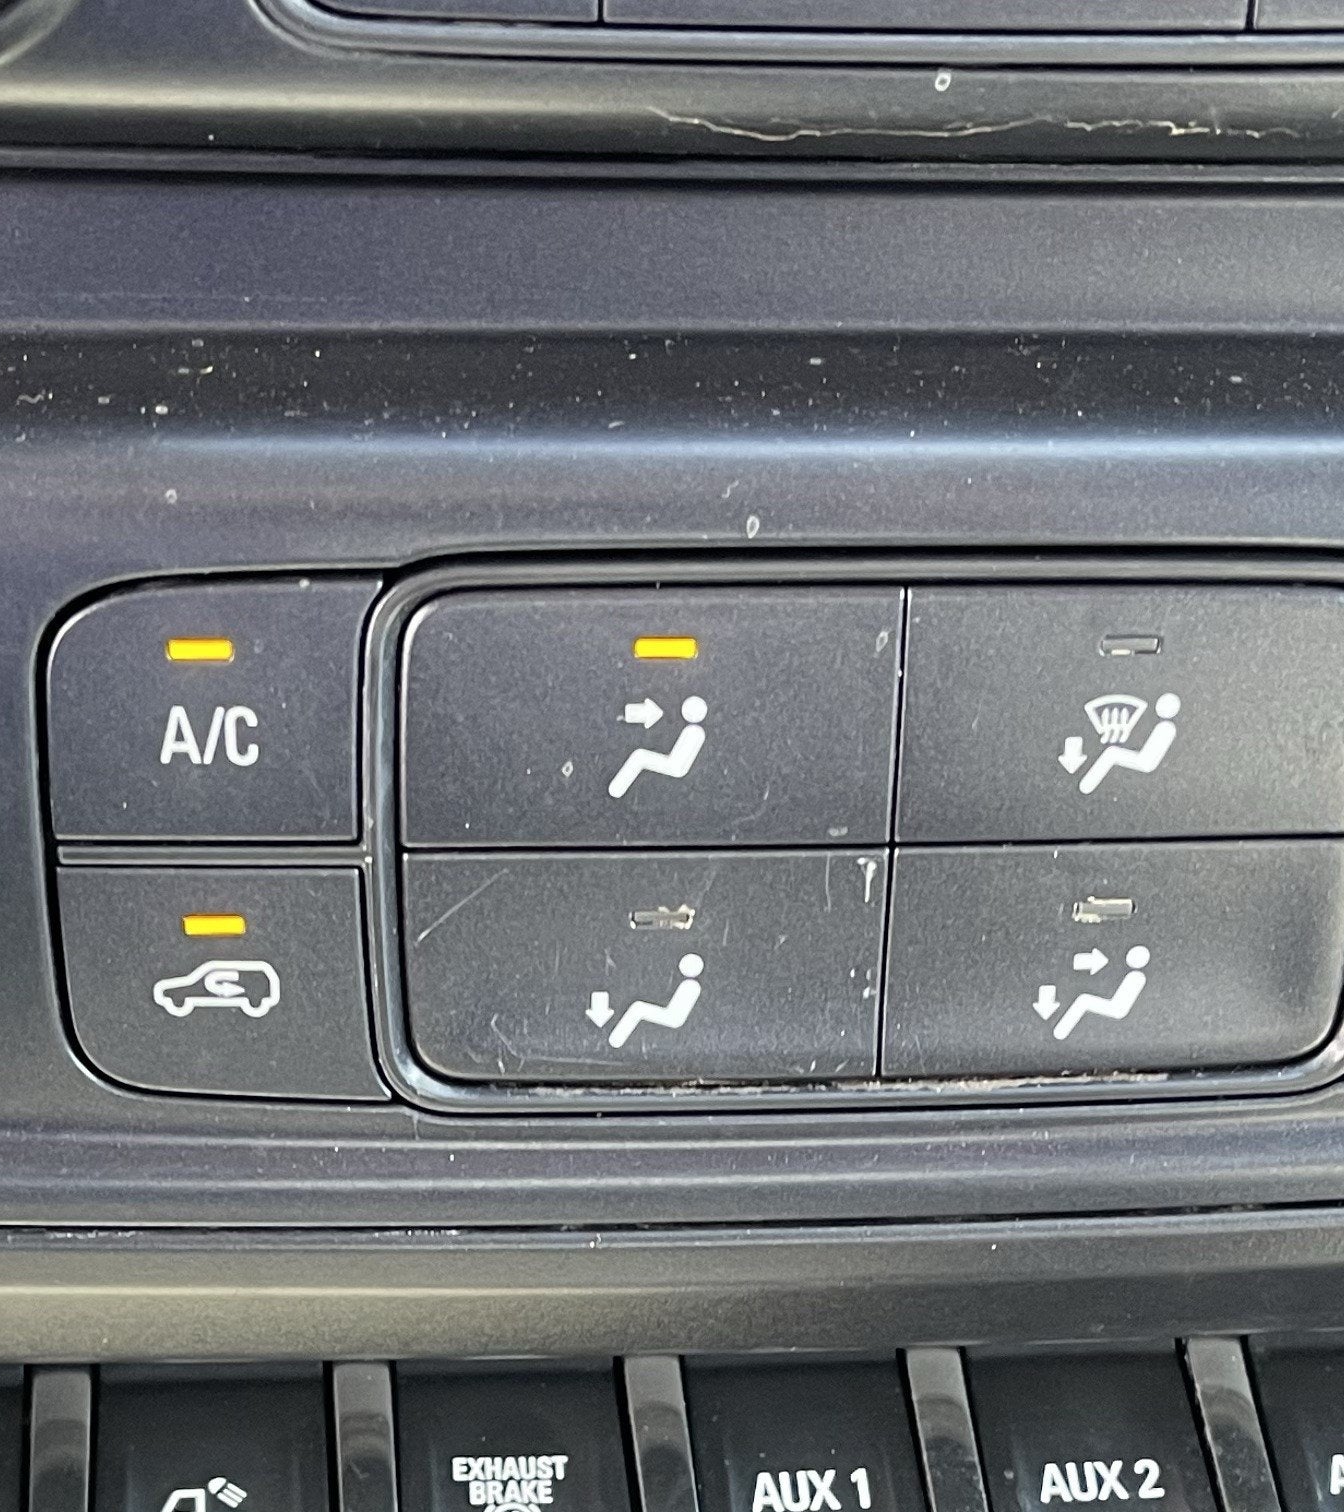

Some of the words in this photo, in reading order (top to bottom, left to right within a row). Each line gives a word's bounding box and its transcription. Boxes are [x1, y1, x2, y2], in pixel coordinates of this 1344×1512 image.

[160, 705, 259, 767] A/C
[452, 1454, 569, 1482] EXHAUST
[850, 1467, 872, 1510] 1
[1040, 1460, 1130, 1504] AUX
[1133, 1458, 1166, 1499] 2
[468, 1479, 554, 1506] BRAKE
